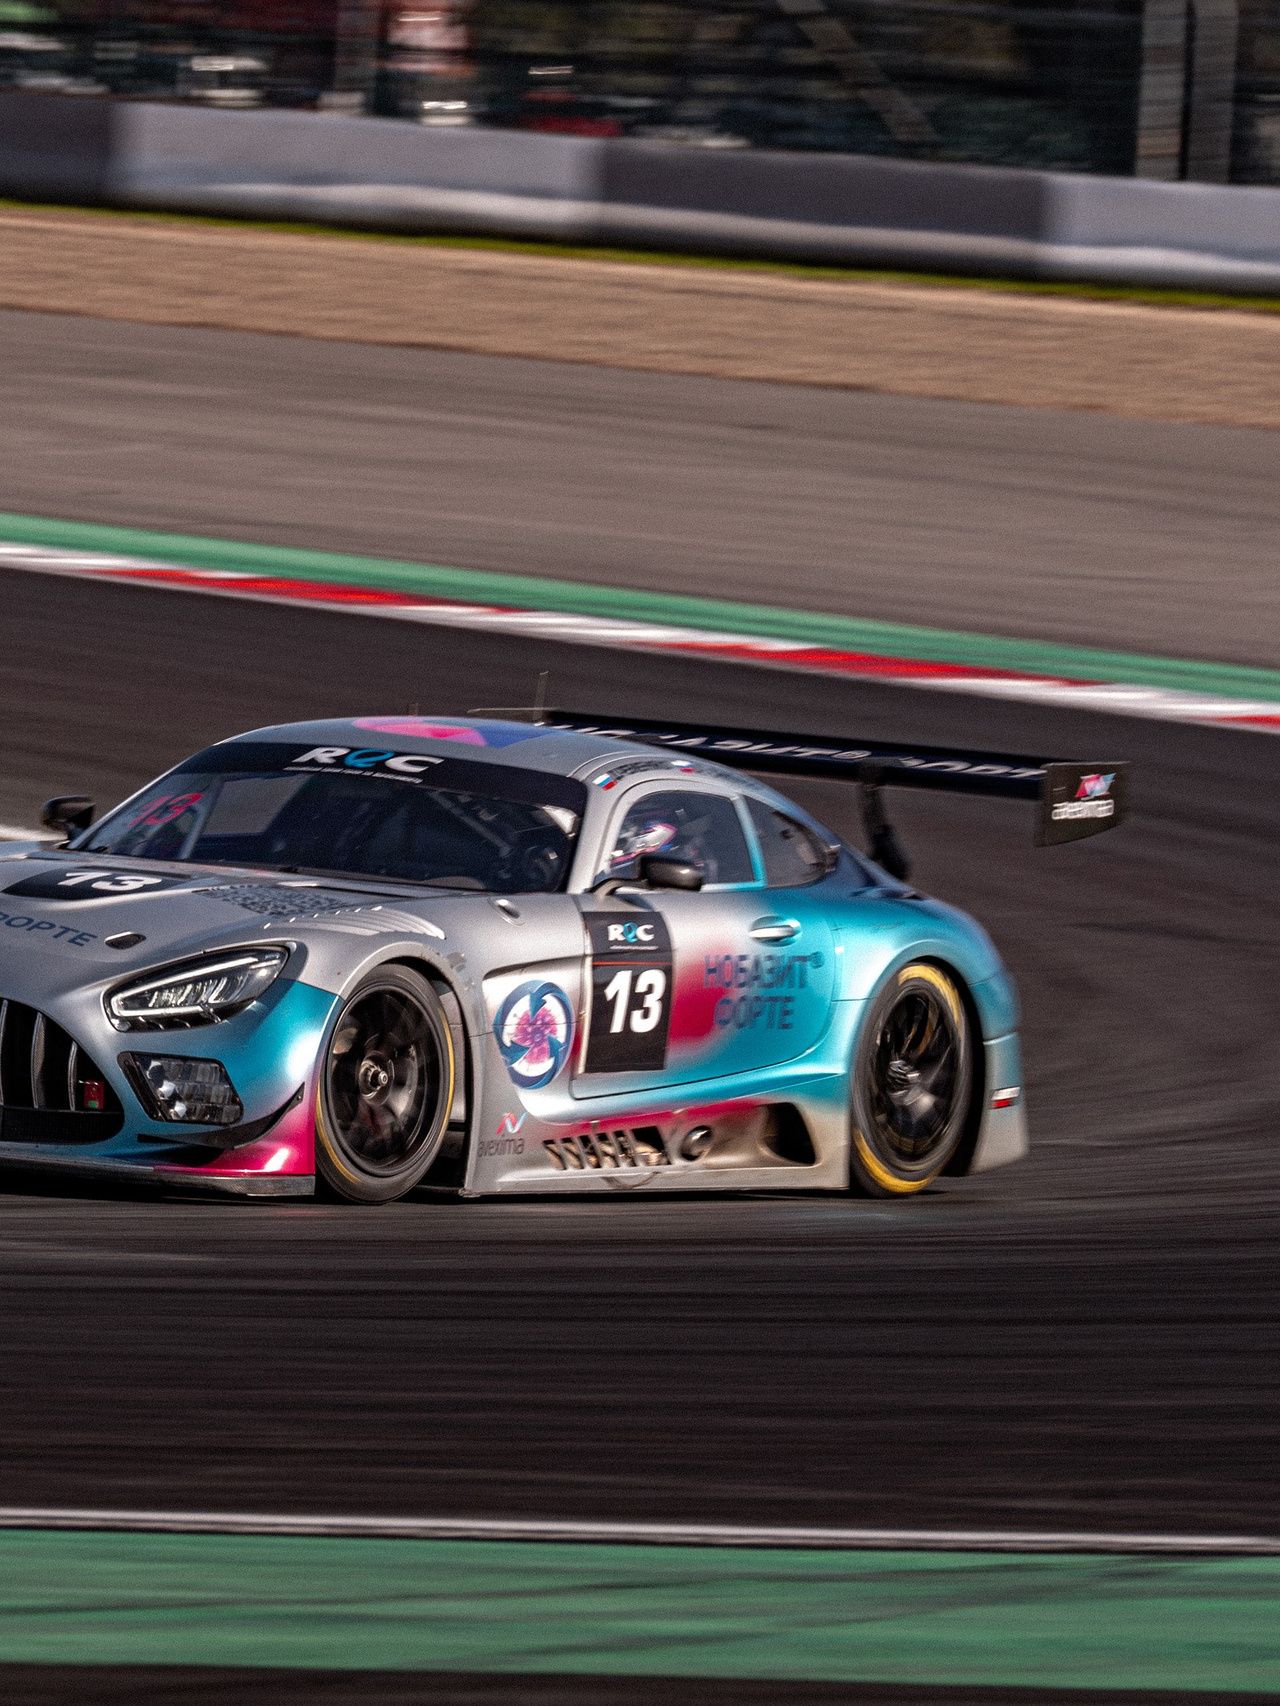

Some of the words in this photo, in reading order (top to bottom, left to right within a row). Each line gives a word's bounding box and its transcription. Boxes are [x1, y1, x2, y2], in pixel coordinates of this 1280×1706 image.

[125, 792, 204, 828] 13
[57, 871, 163, 892] 13
[603, 968, 668, 1035] 13
